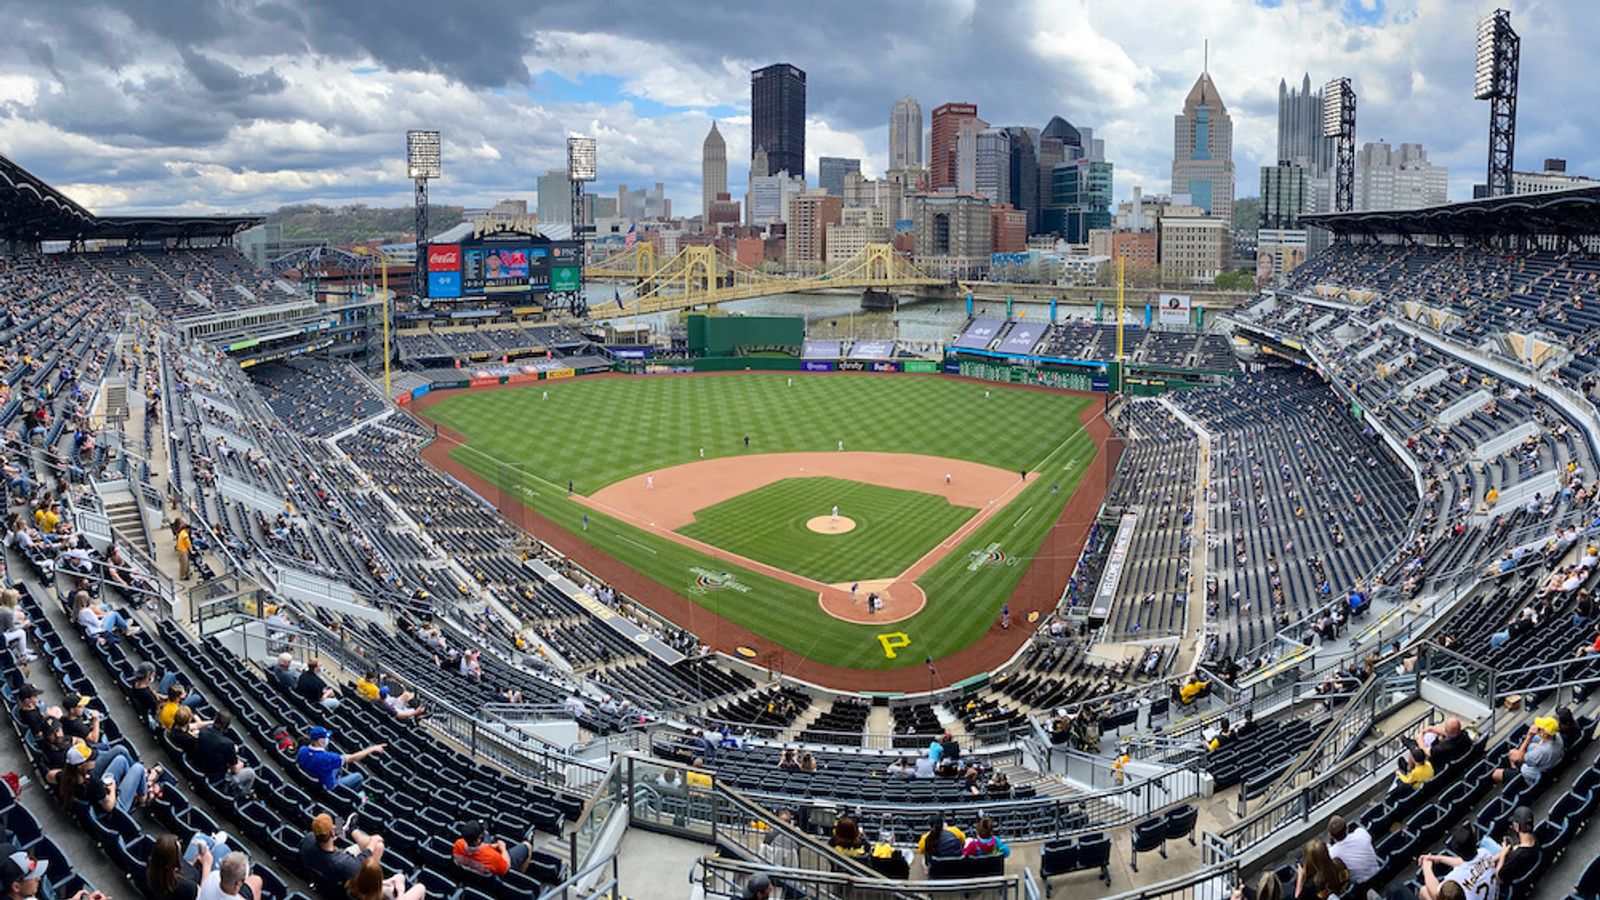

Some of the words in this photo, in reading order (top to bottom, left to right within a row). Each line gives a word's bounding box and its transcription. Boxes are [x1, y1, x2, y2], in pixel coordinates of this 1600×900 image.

[474, 220, 504, 240] PNC
[505, 216, 542, 238] PARK
[561, 247, 578, 257] PNC
[838, 361, 864, 371] xfinity
[874, 363, 895, 372] FedEx
[878, 632, 911, 659] P
